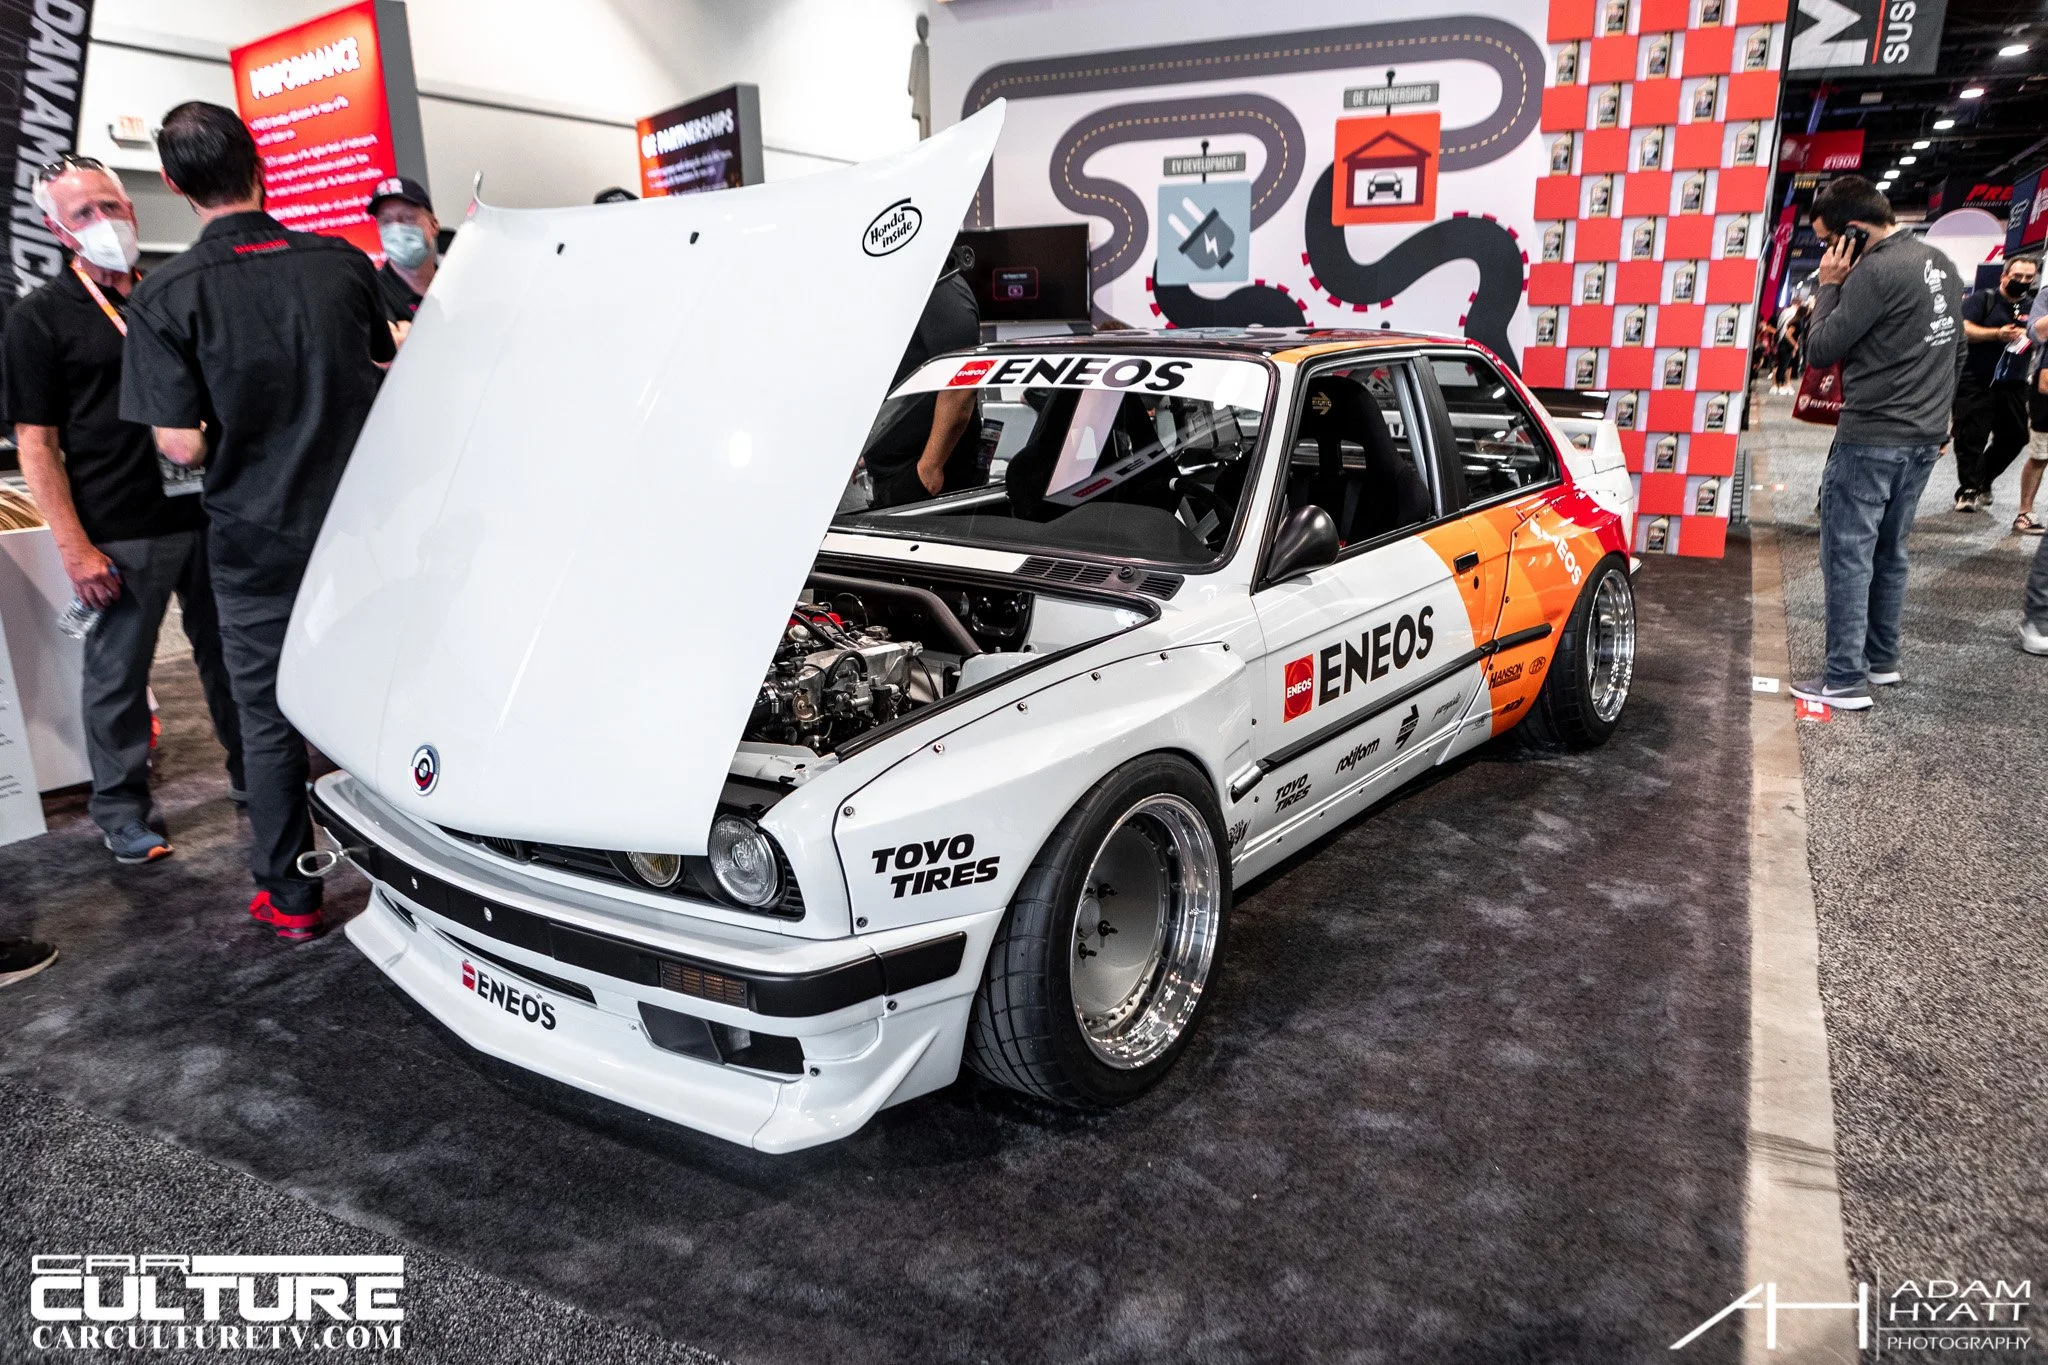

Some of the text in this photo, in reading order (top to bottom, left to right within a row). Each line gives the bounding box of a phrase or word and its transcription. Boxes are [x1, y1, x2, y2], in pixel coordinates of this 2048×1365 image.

[1883, 0, 1917, 64] SUS
[1367, 85, 1431, 105] PARTNERSHIPS
[1172, 155, 1237, 174] EV DEVELOPMENT
[870, 212, 905, 245] Honda
[882, 221, 913, 248] inside
[957, 357, 1193, 391] ENEOS ENEOS
[1286, 678, 1312, 699] ENEOS
[1318, 605, 1434, 707] ENEOS
[1488, 662, 1524, 690] HANSON
[1335, 738, 1380, 774] rotiform
[1275, 773, 1308, 801] TOYO
[1275, 784, 1312, 814] TIRES
[871, 833, 975, 874] TOYO
[890, 856, 1001, 899] TIRES
[477, 969, 557, 1031] ENEOS
